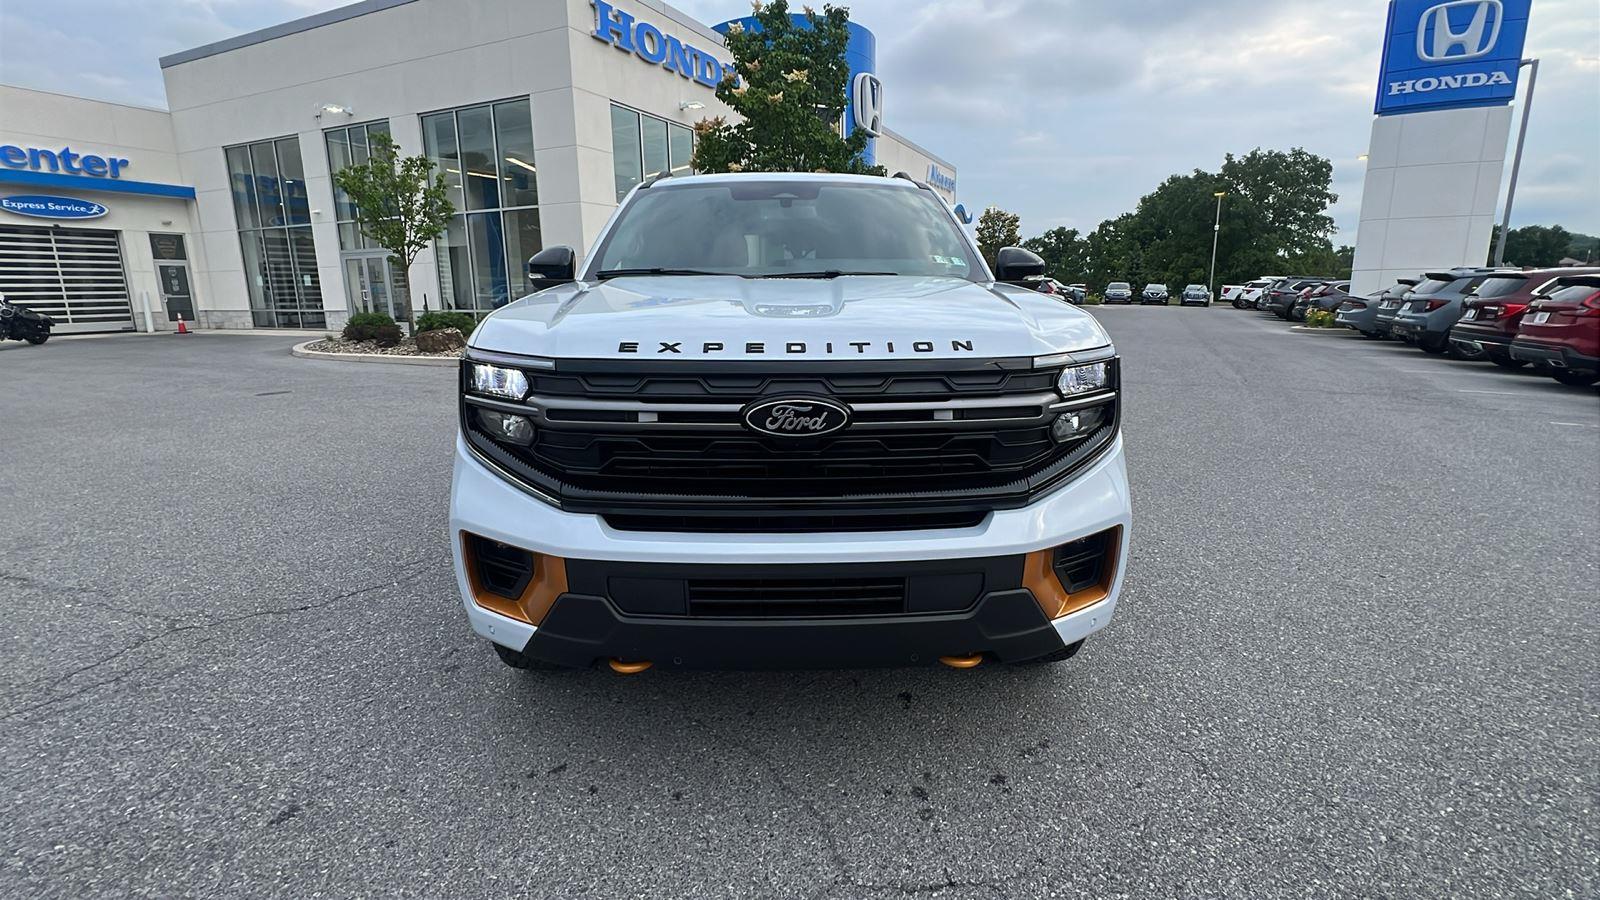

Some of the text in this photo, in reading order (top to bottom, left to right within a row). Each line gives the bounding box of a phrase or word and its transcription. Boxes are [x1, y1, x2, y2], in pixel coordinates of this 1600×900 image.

[1388, 71, 1513, 95] HONDA
[0, 145, 129, 178] enter
[2, 199, 88, 213] Express Service
[618, 340, 974, 354] EXPEDITION
[765, 404, 828, 432] Ford
